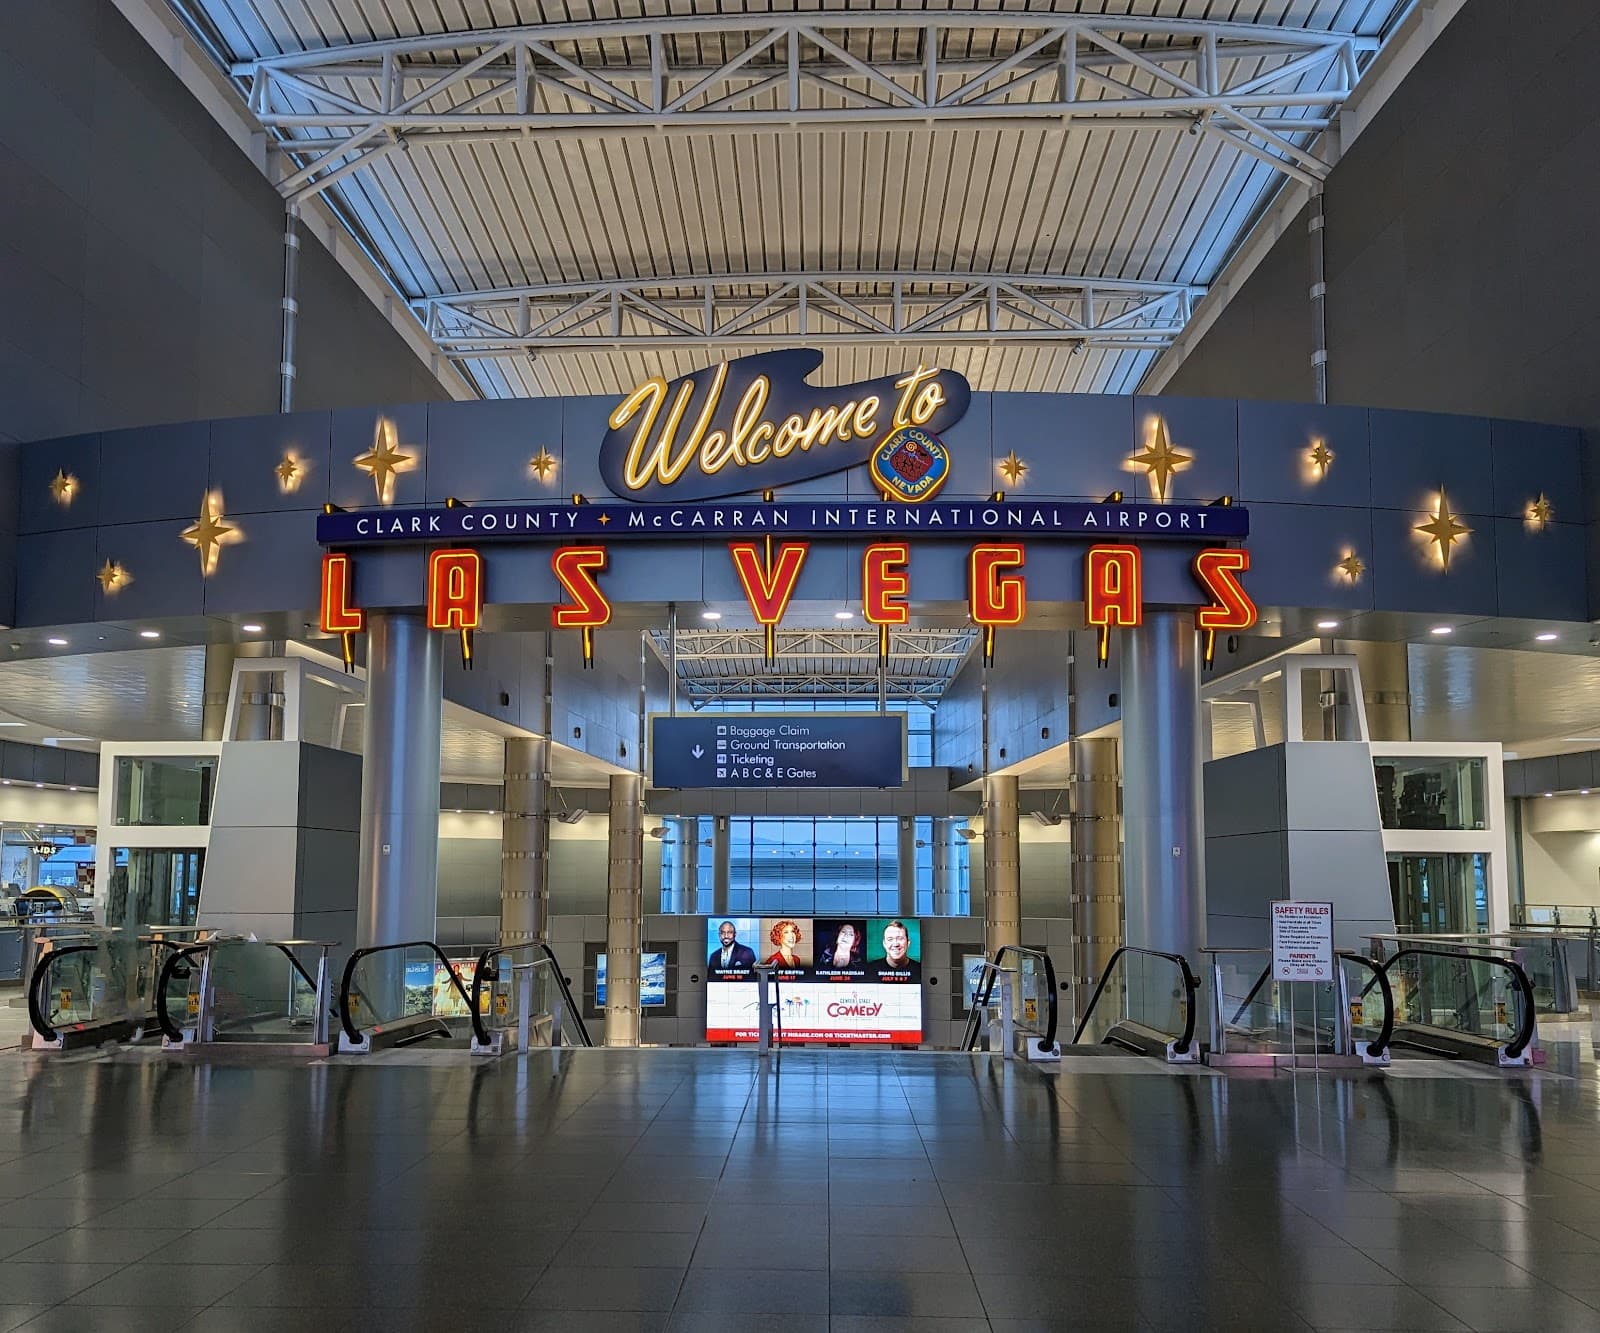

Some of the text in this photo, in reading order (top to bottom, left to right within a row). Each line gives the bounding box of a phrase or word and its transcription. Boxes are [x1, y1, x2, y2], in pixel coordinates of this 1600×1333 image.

[608, 361, 946, 490] Welcome to
[881, 429, 943, 461] CLARK COUNTY
[891, 475, 935, 494] NEVADA
[356, 508, 1209, 535] CLARK COUNTY McCARRAN INTERNATIONAL AIRPORT
[320, 542, 1257, 633] LAS VEGAS
[730, 724, 810, 738] Baggage Claim
[730, 739, 846, 753] Ground Transportation
[730, 753, 774, 767] Ticketing
[730, 767, 817, 779] A B C & E Gates
[32, 846, 57, 855] KIDS
[1274, 906, 1329, 915] SAFETY RULES
[827, 1002, 883, 1018] COMEDY
